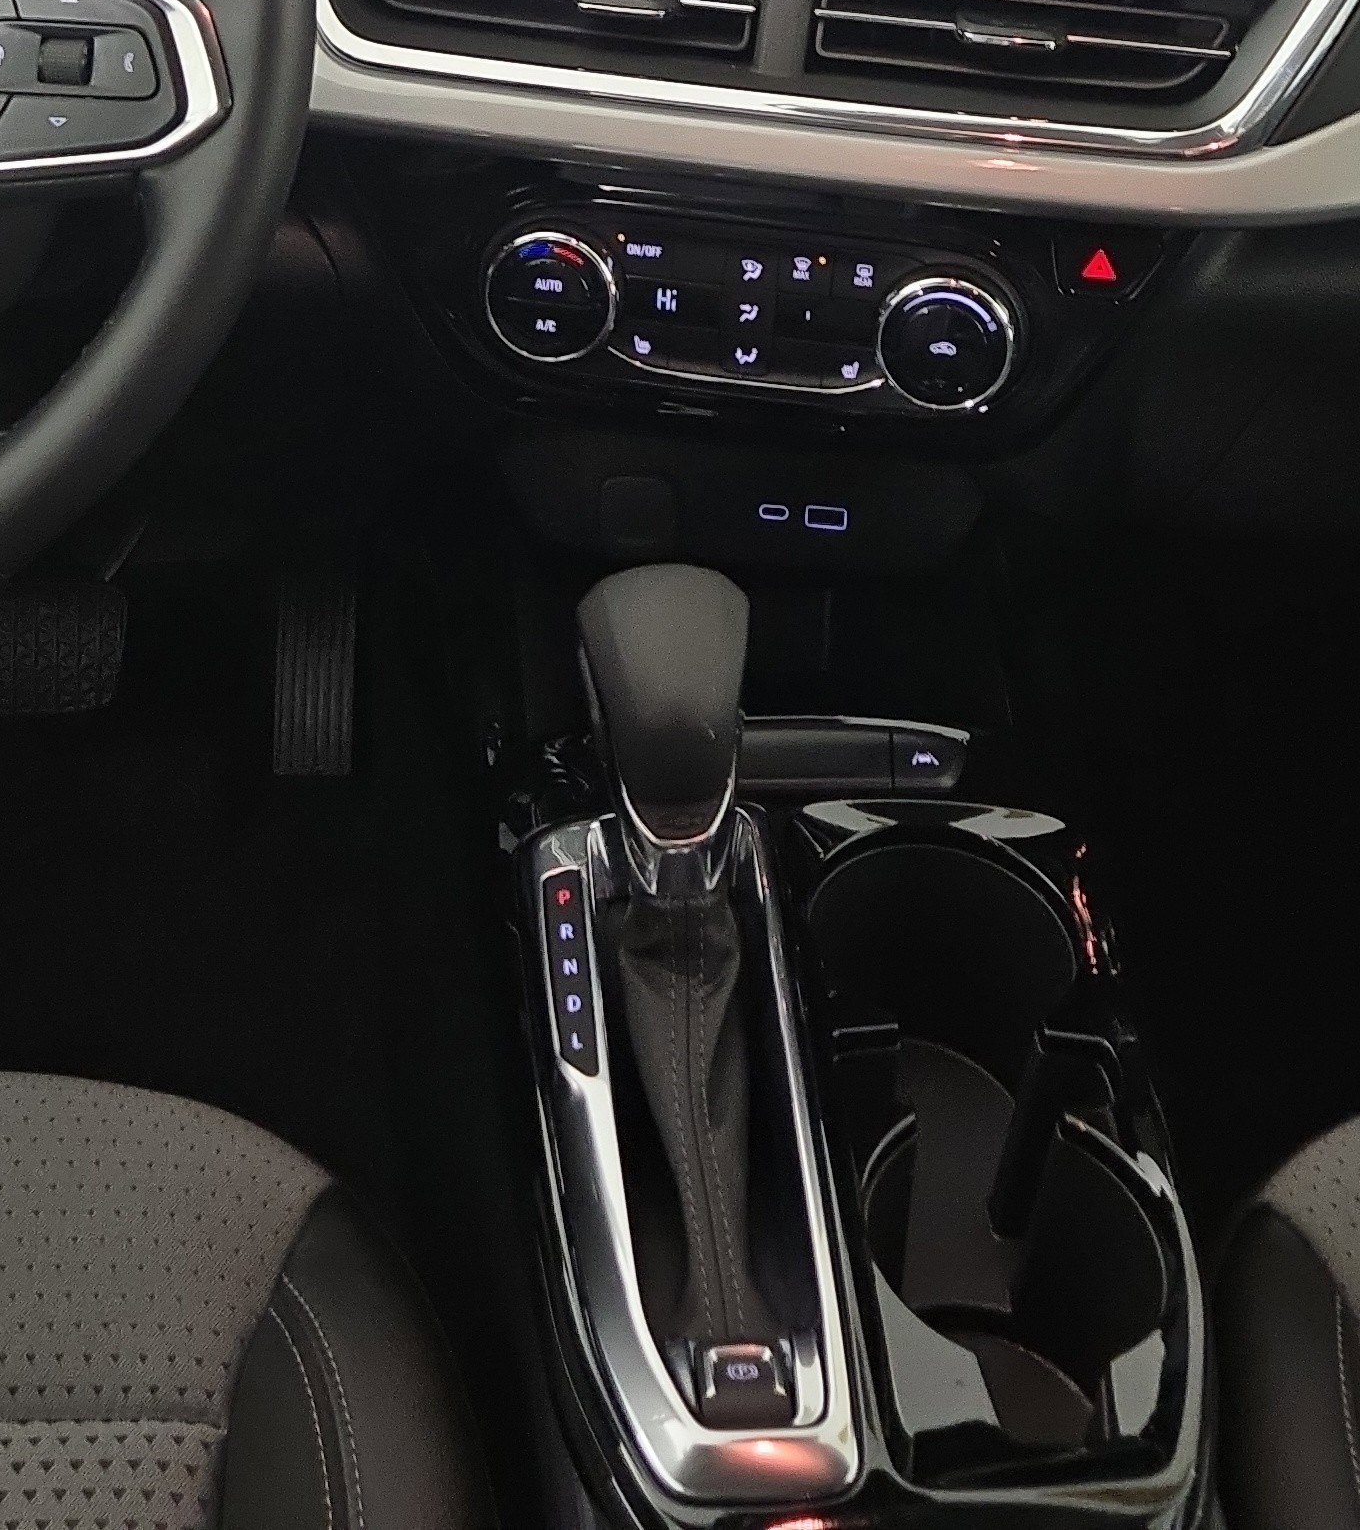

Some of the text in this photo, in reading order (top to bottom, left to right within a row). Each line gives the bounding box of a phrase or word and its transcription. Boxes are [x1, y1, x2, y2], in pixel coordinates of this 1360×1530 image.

[626, 243, 663, 258] ON/OFF
[534, 278, 563, 293] AUTO
[656, 287, 678, 312] Hi
[535, 318, 557, 333] A/C
[557, 889, 571, 905] P
[559, 923, 575, 941] R
[562, 958, 579, 976] N
[566, 994, 582, 1013] D
[571, 1031, 584, 1050] L
